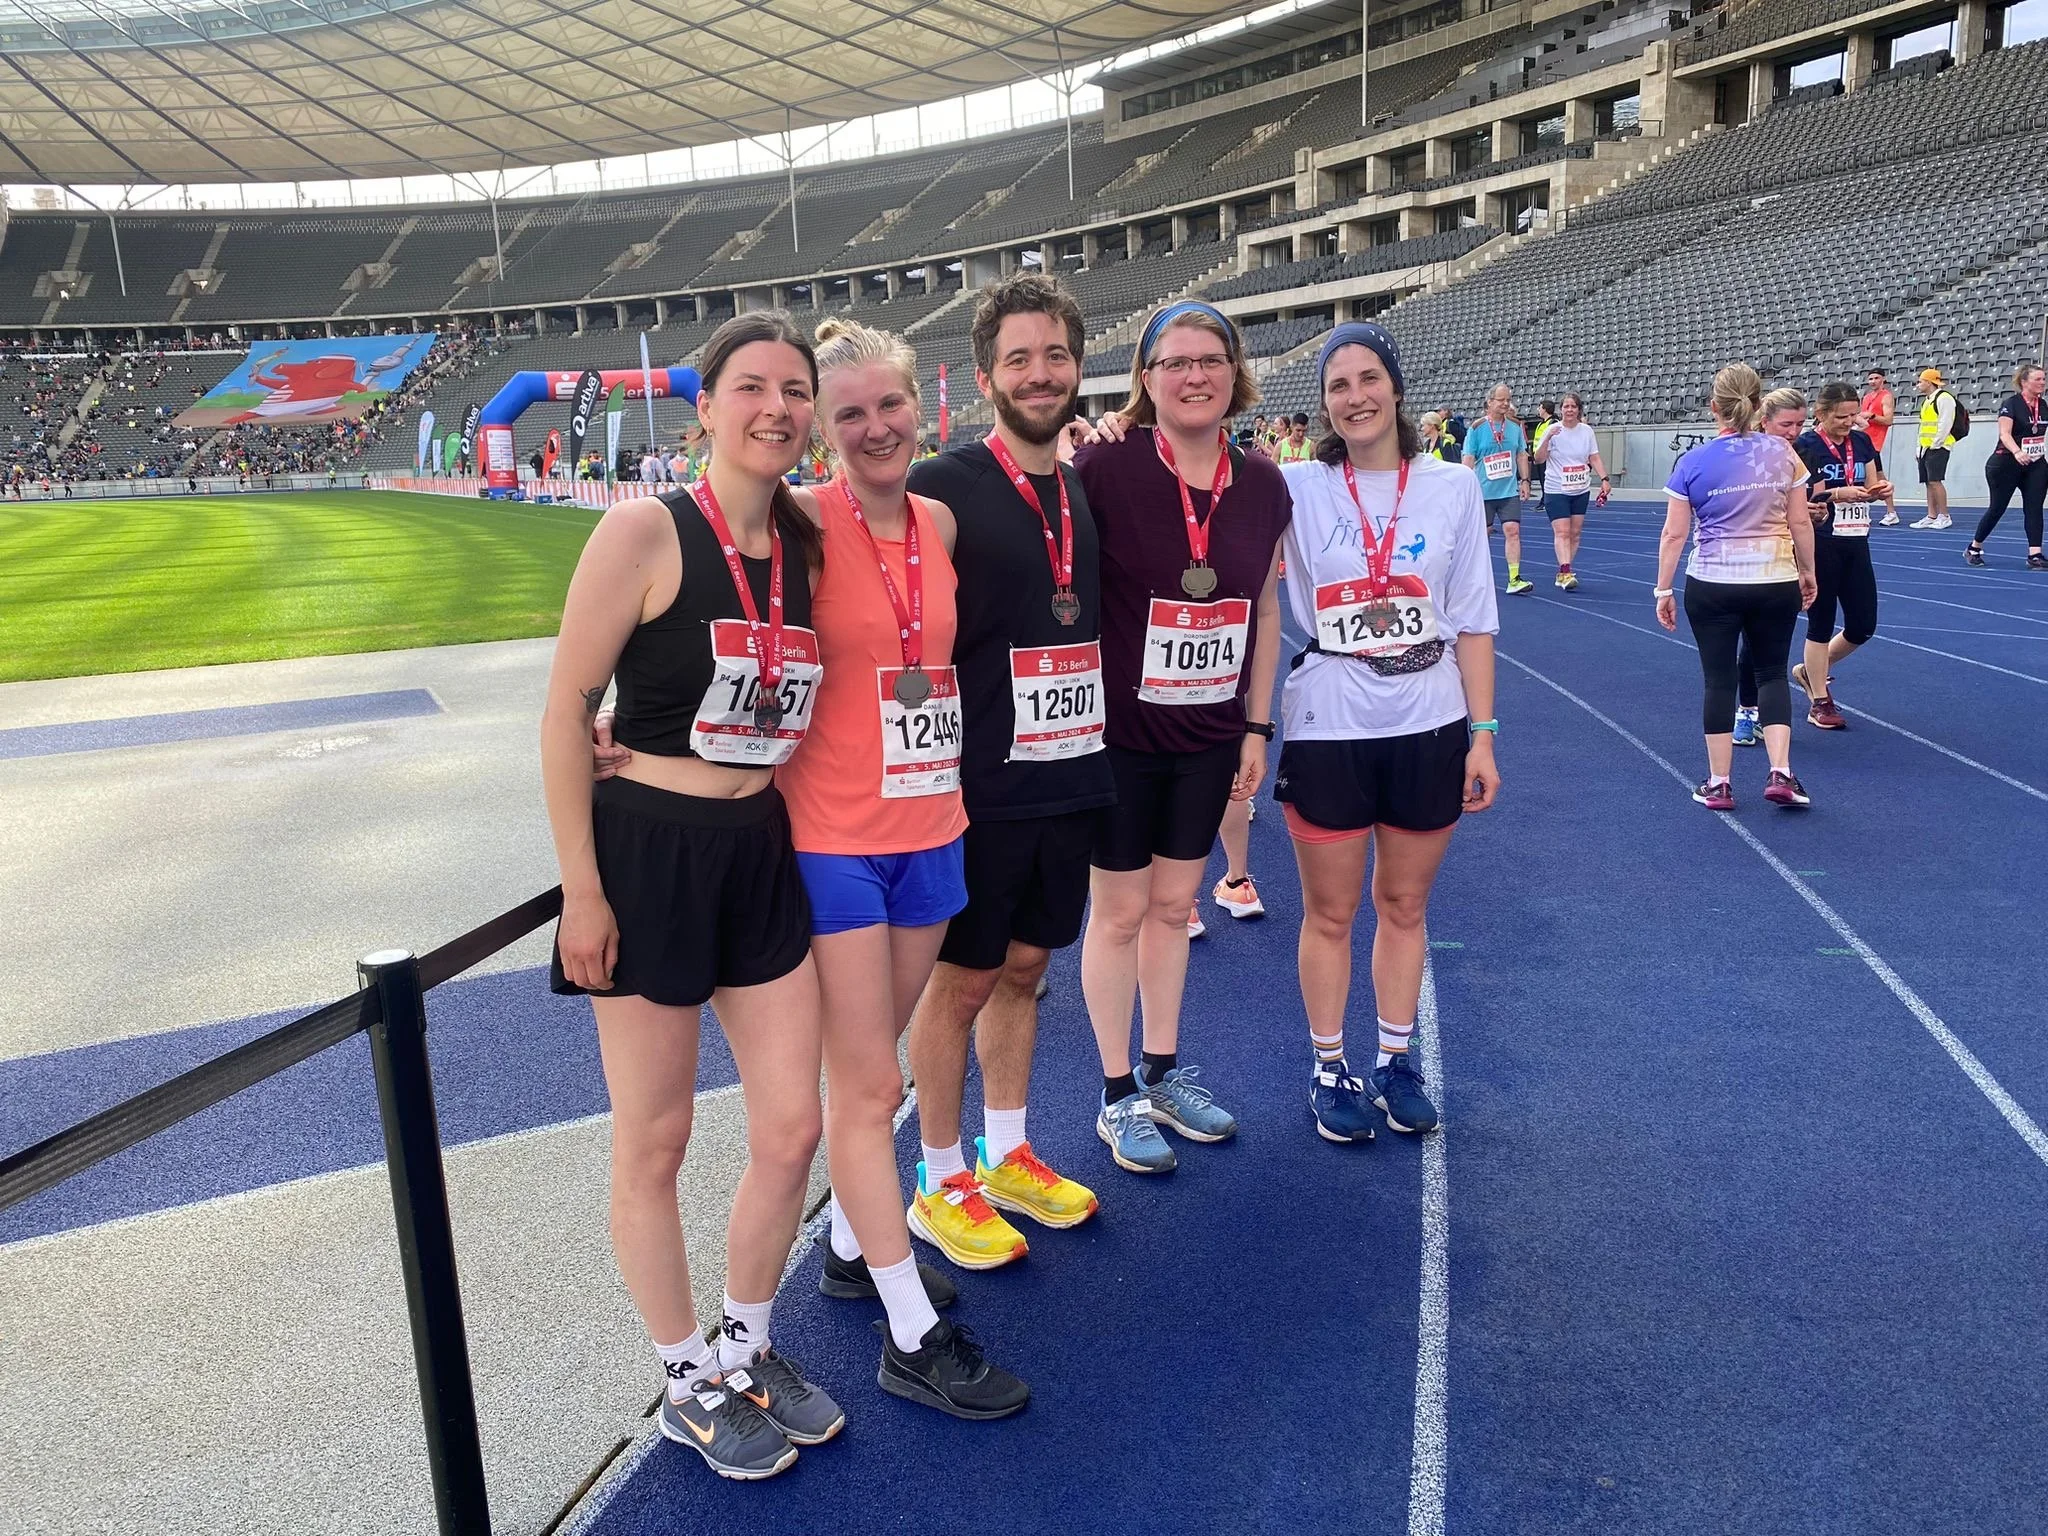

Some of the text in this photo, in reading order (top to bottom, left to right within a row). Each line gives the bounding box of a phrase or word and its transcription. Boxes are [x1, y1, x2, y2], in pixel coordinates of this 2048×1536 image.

[578, 376, 598, 416] artiva
[624, 384, 663, 397] ern
[463, 407, 480, 438] artiva
[1488, 460, 1510, 472] 10770
[701, 499, 715, 519] Berlin
[734, 570, 744, 592] Berlin
[1360, 589, 1373, 600] 25
[1196, 618, 1208, 627] 25
[1332, 606, 1423, 645] 1253
[1160, 637, 1235, 671] 10974
[1057, 662, 1068, 671] 25
[1069, 658, 1088, 670] Berlin
[728, 674, 812, 717] 1057
[1027, 683, 1095, 721] 12507
[737, 727, 745, 735] 5.
[895, 710, 960, 750] 12446
[1057, 730, 1067, 738] MAI
[1068, 729, 1081, 737] 2024
[745, 742, 761, 751] AOK
[931, 761, 942, 769] MAI
[942, 760, 954, 768] 2024
